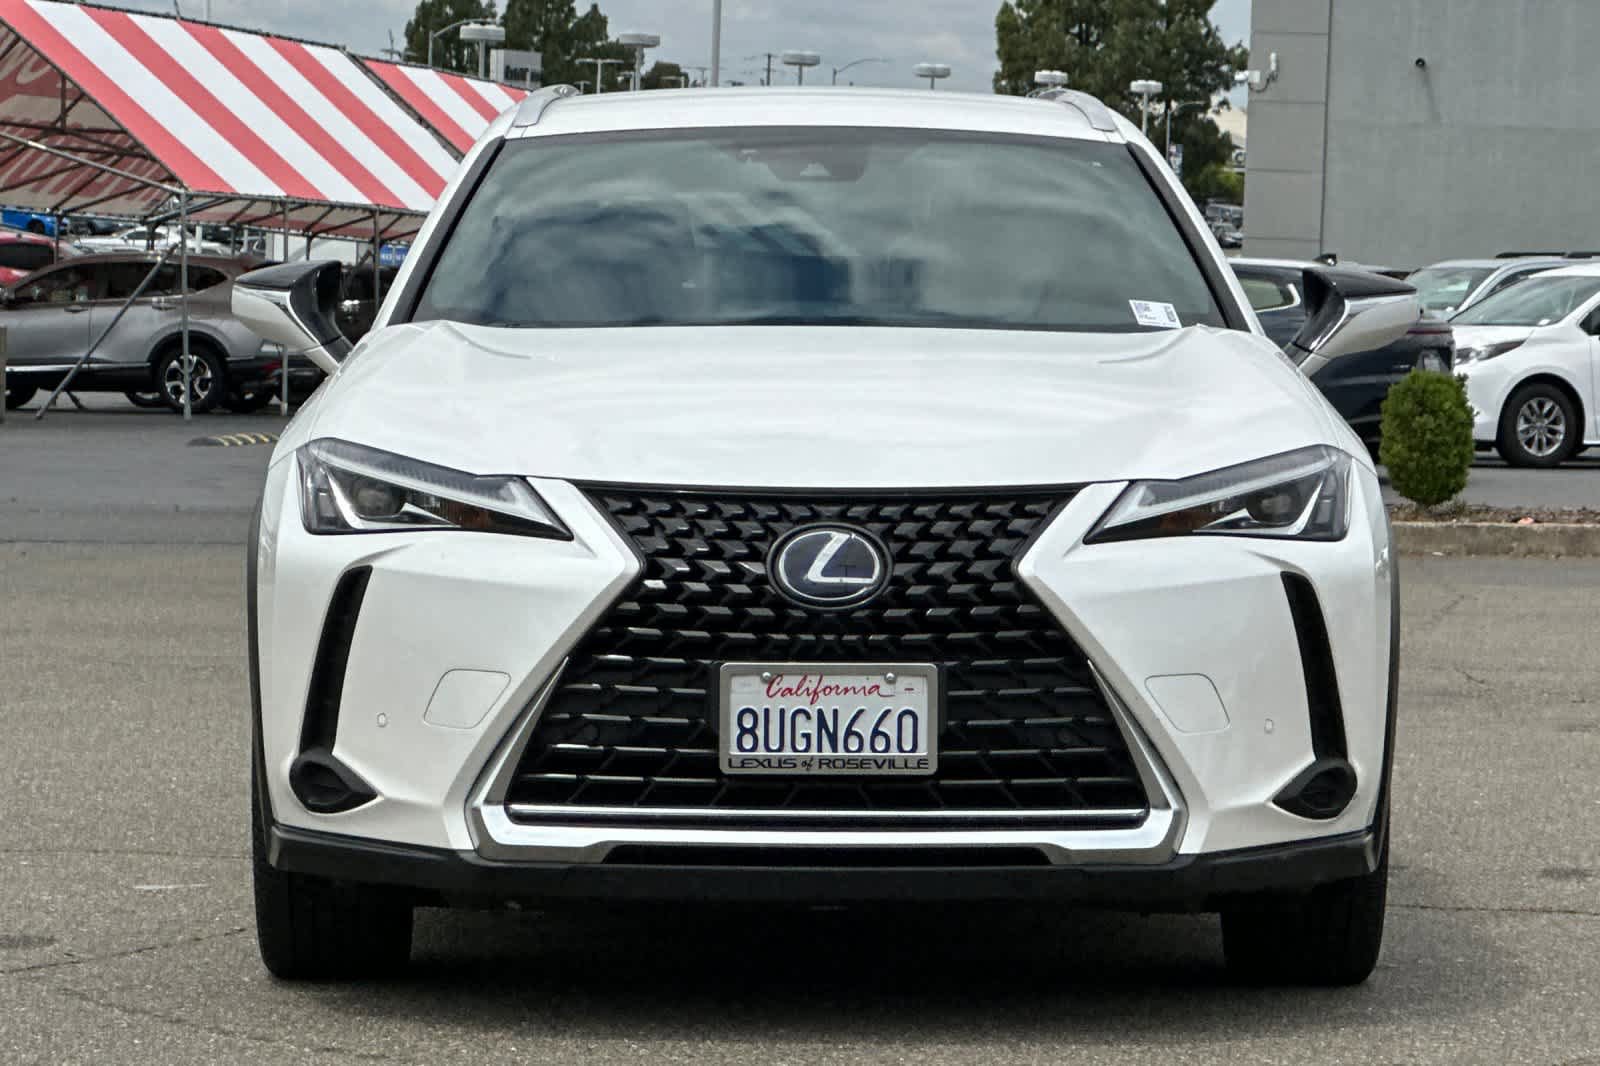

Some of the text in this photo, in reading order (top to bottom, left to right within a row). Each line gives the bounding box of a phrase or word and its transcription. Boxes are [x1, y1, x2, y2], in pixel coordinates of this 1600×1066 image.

[766, 673, 895, 705] California
[736, 708, 919, 753] 8UGN660
[728, 757, 929, 771] LEXUS of ROSEVILLE
